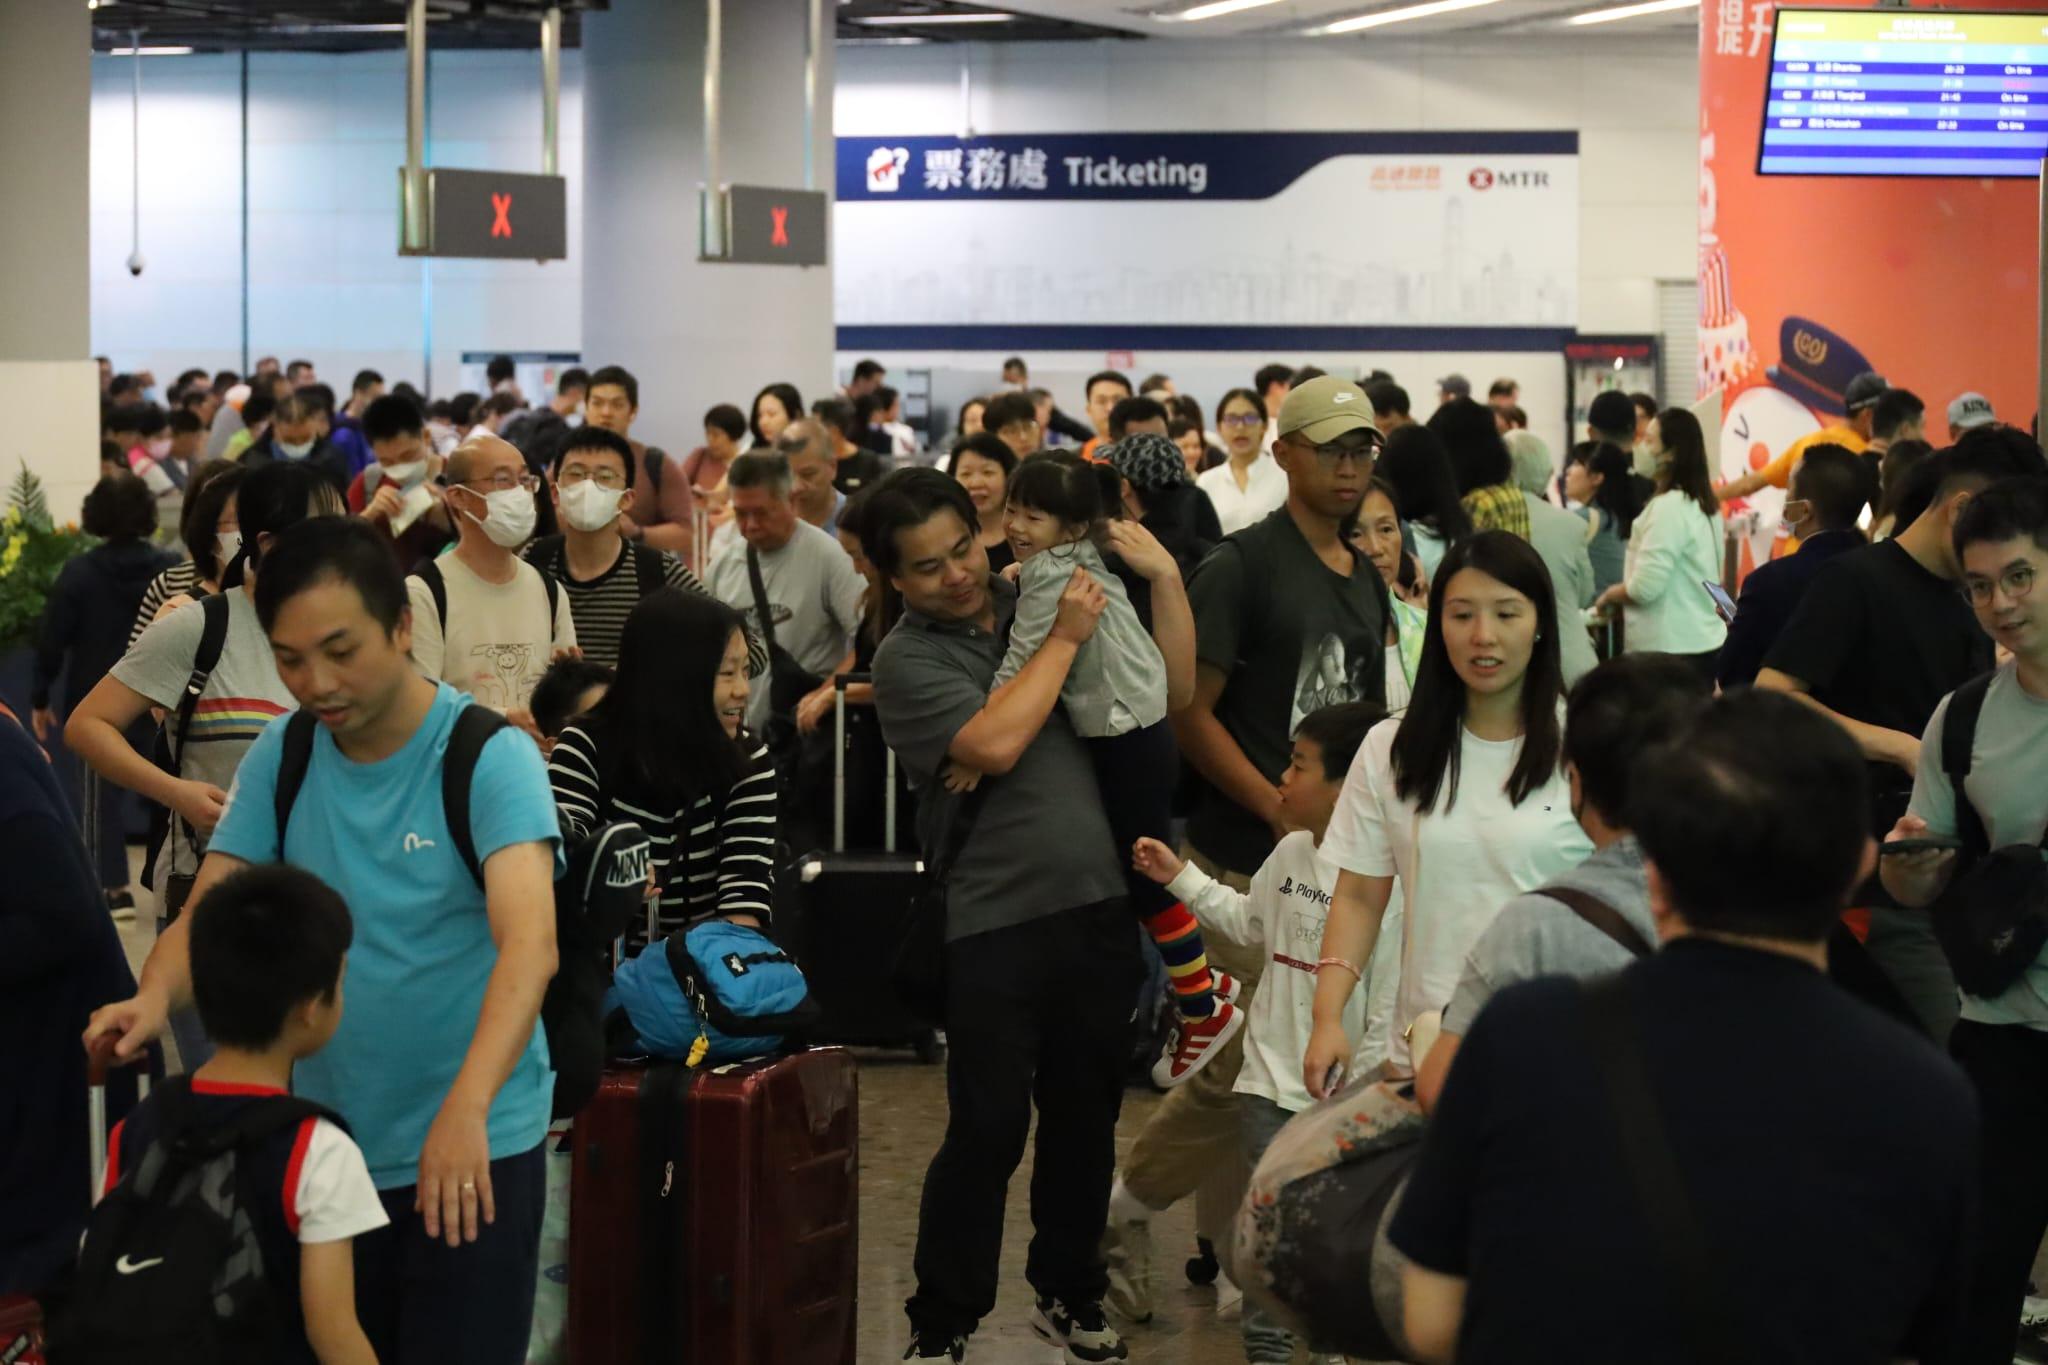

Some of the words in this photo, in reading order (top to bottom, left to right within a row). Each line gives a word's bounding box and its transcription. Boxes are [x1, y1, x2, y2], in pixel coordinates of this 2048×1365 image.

[923, 147, 1048, 191] 票務處
[1063, 157, 1208, 193] Ticketing
[1498, 171, 1550, 188] MTR
[1296, 883, 1333, 906] PlaySta
